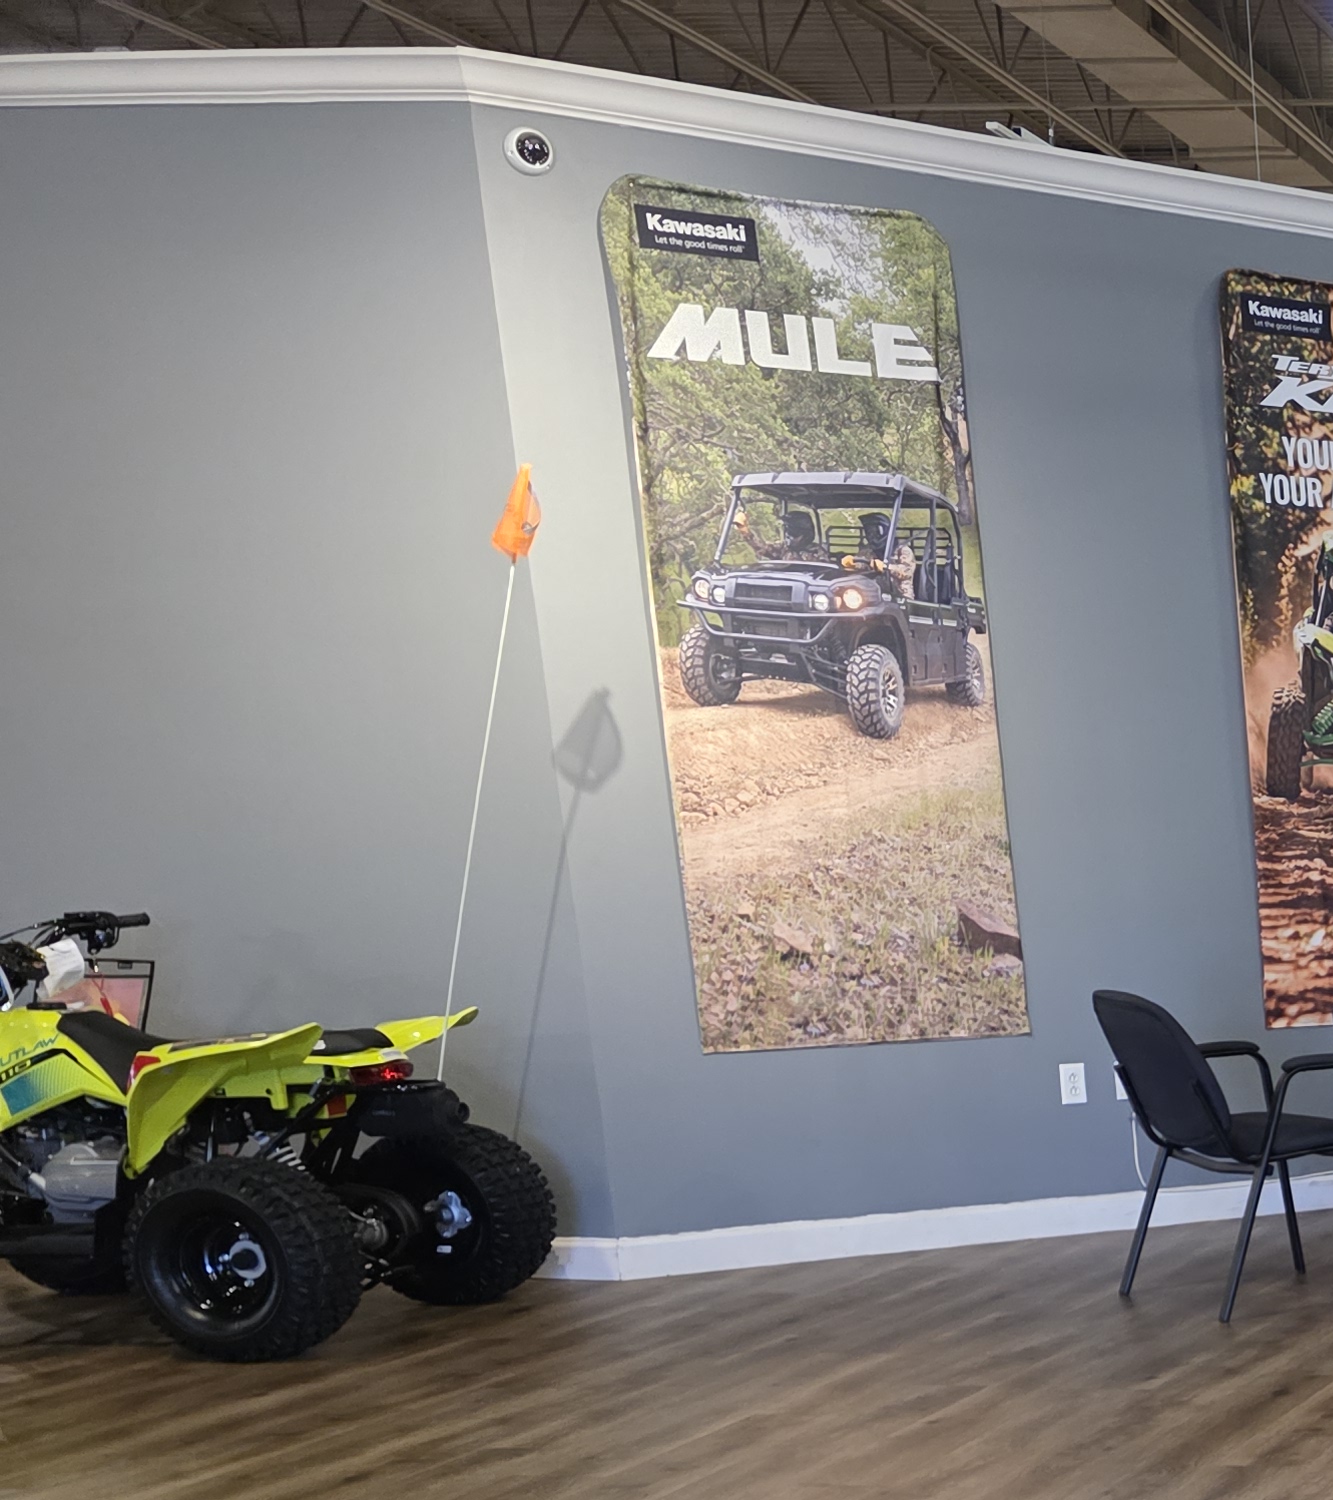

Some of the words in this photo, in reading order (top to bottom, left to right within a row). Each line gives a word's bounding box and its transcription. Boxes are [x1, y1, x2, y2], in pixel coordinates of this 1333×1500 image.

[645, 212, 747, 242] Kawasaki
[654, 234, 666, 246] Let
[667, 236, 682, 248] the
[684, 238, 706, 252] good
[706, 240, 728, 252] times
[729, 242, 745, 254] roll
[1248, 300, 1323, 324] Kawasaki
[1254, 319, 1263, 327] Let
[1264, 320, 1275, 329] the
[1276, 322, 1292, 332] good
[1292, 324, 1309, 333] times
[1309, 325, 1320, 334] roll
[646, 302, 942, 384] MULE
[1258, 472, 1324, 509] YOUR
[0, 1033, 61, 1067] UTLAW
